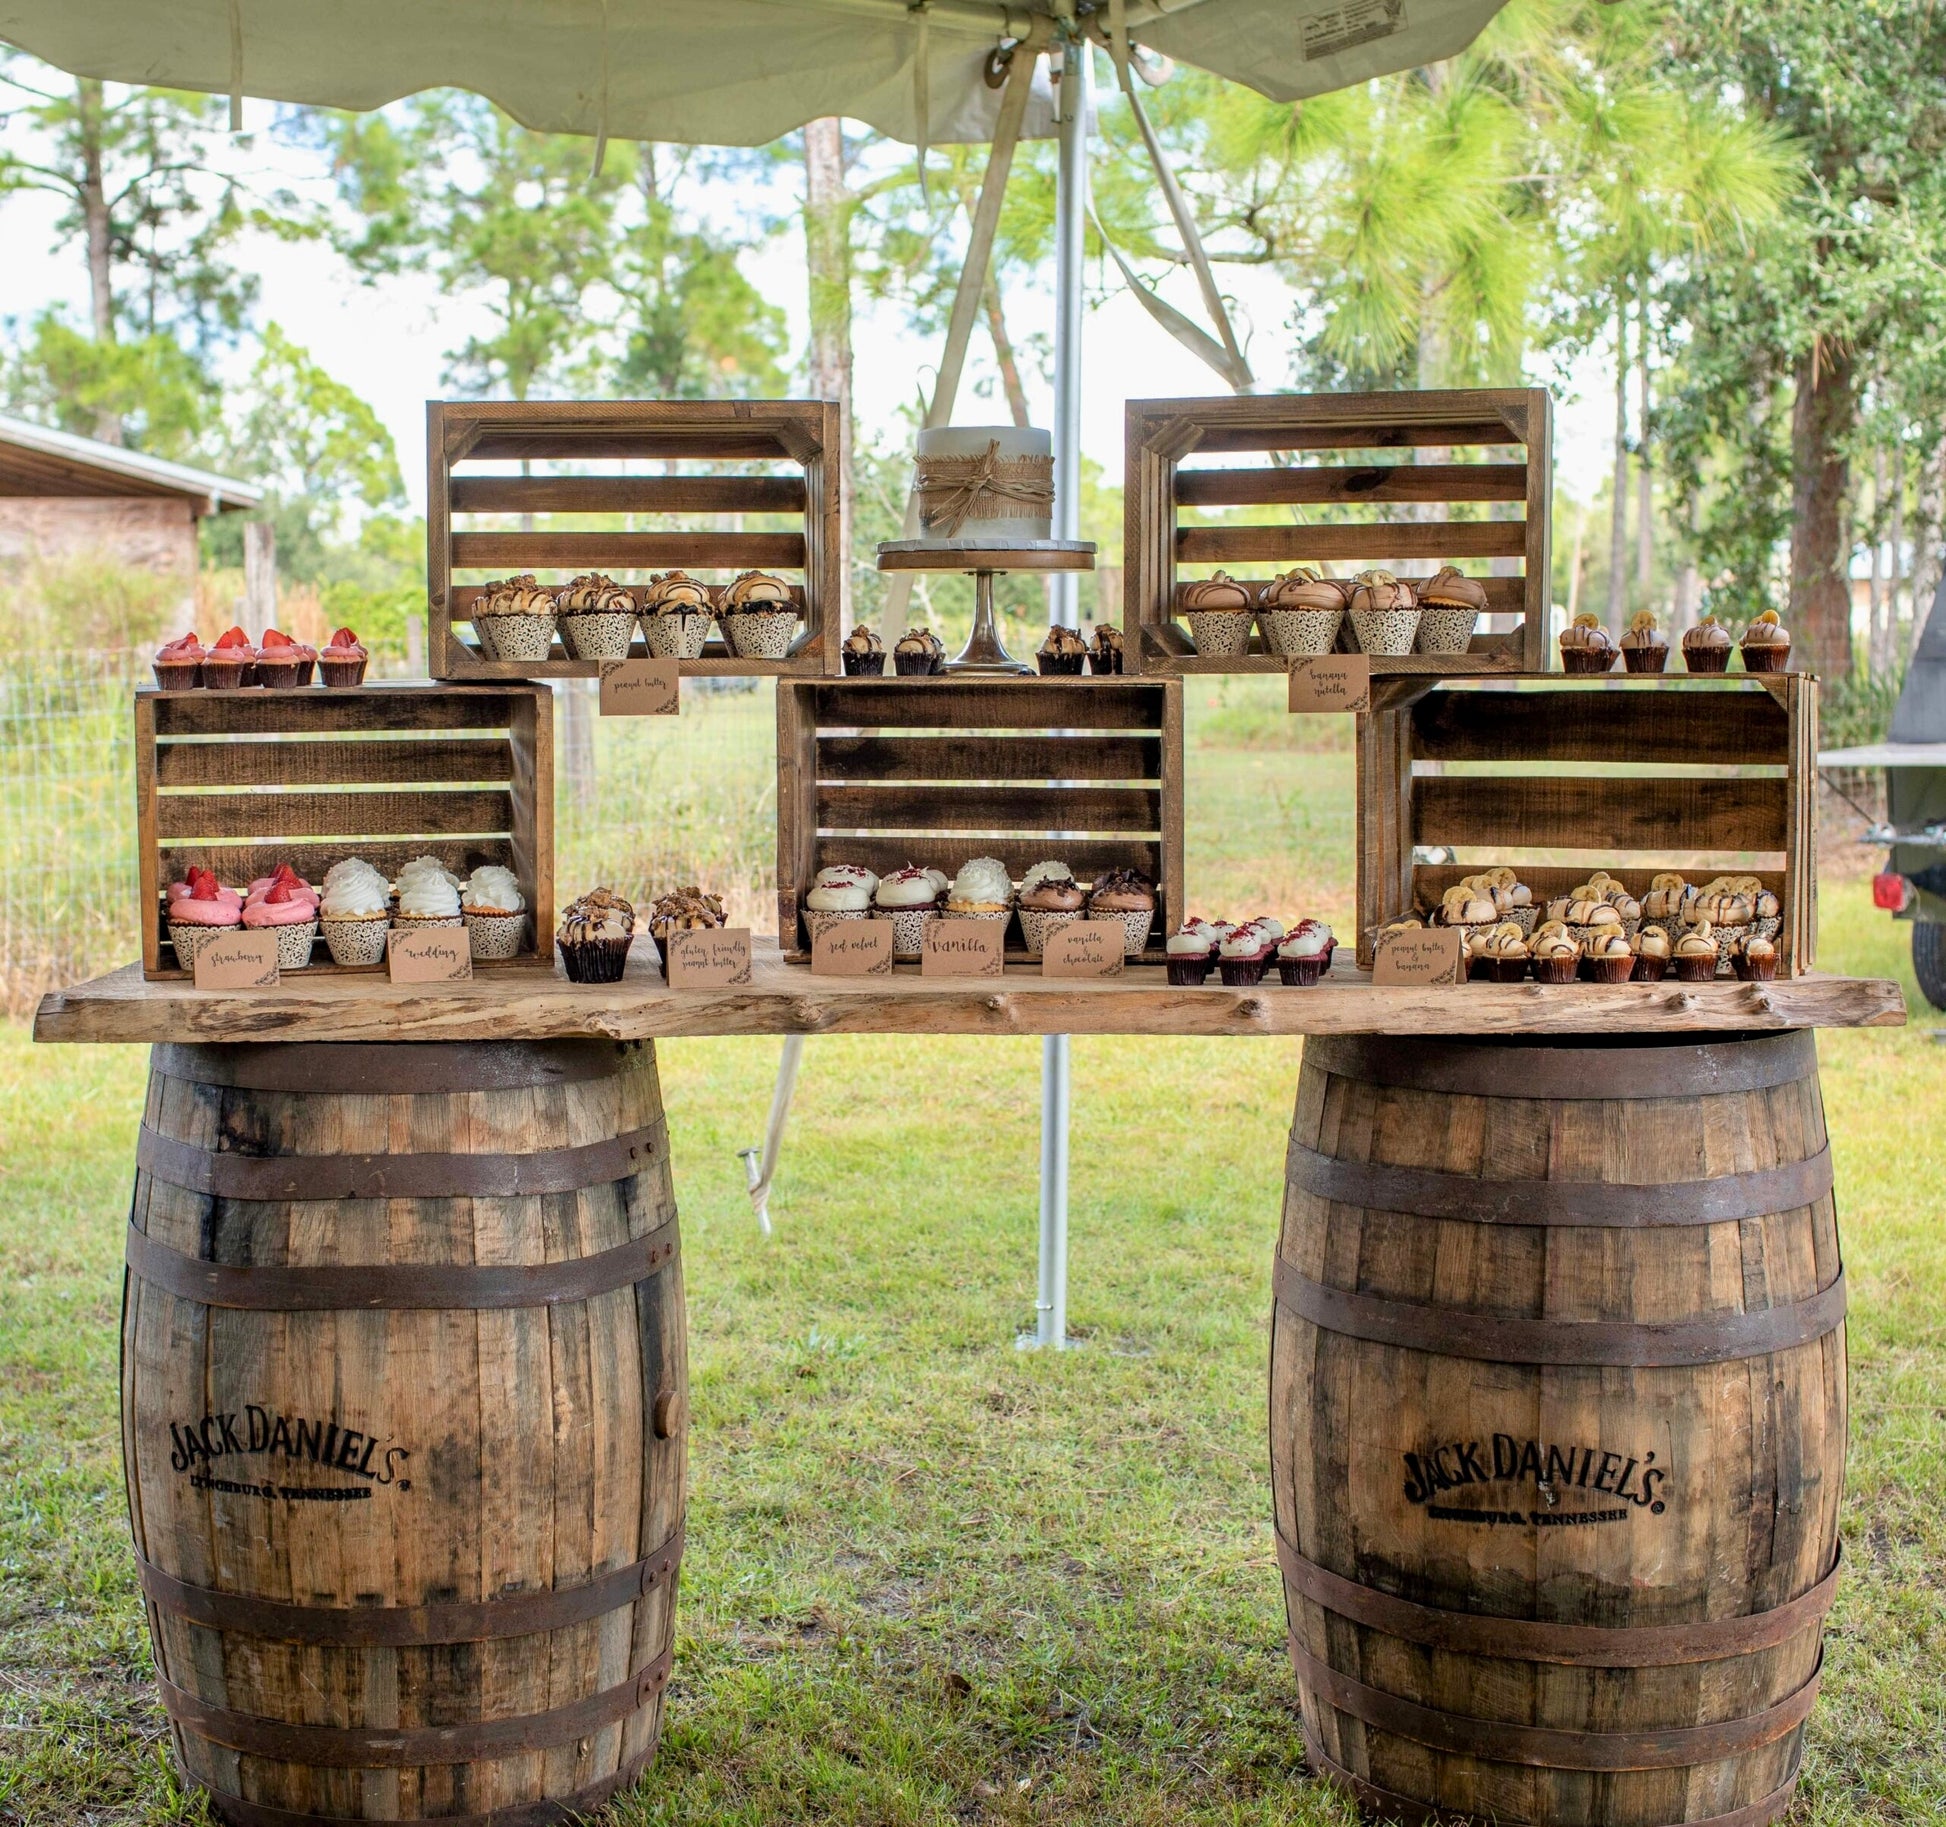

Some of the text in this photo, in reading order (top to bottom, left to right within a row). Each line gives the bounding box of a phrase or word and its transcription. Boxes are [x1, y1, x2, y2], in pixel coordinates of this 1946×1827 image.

[1309, 669, 1348, 681] banana
[1314, 684, 1347, 697] nutella
[828, 936, 879, 953] red velvet
[1067, 932, 1104, 945] vanilla
[404, 944, 459, 962] wedding
[680, 940, 747, 959] gluten friendly
[931, 938, 989, 954] vanilla
[1391, 942, 1447, 955] peanut butter
[210, 950, 264, 967] strawberry
[712, 956, 738, 969] butter
[1062, 953, 1105, 966] chocolate
[1395, 961, 1431, 973] banana
[169, 1413, 242, 1474] JACK
[1403, 1432, 1665, 1508] JACK DANIEL'S
